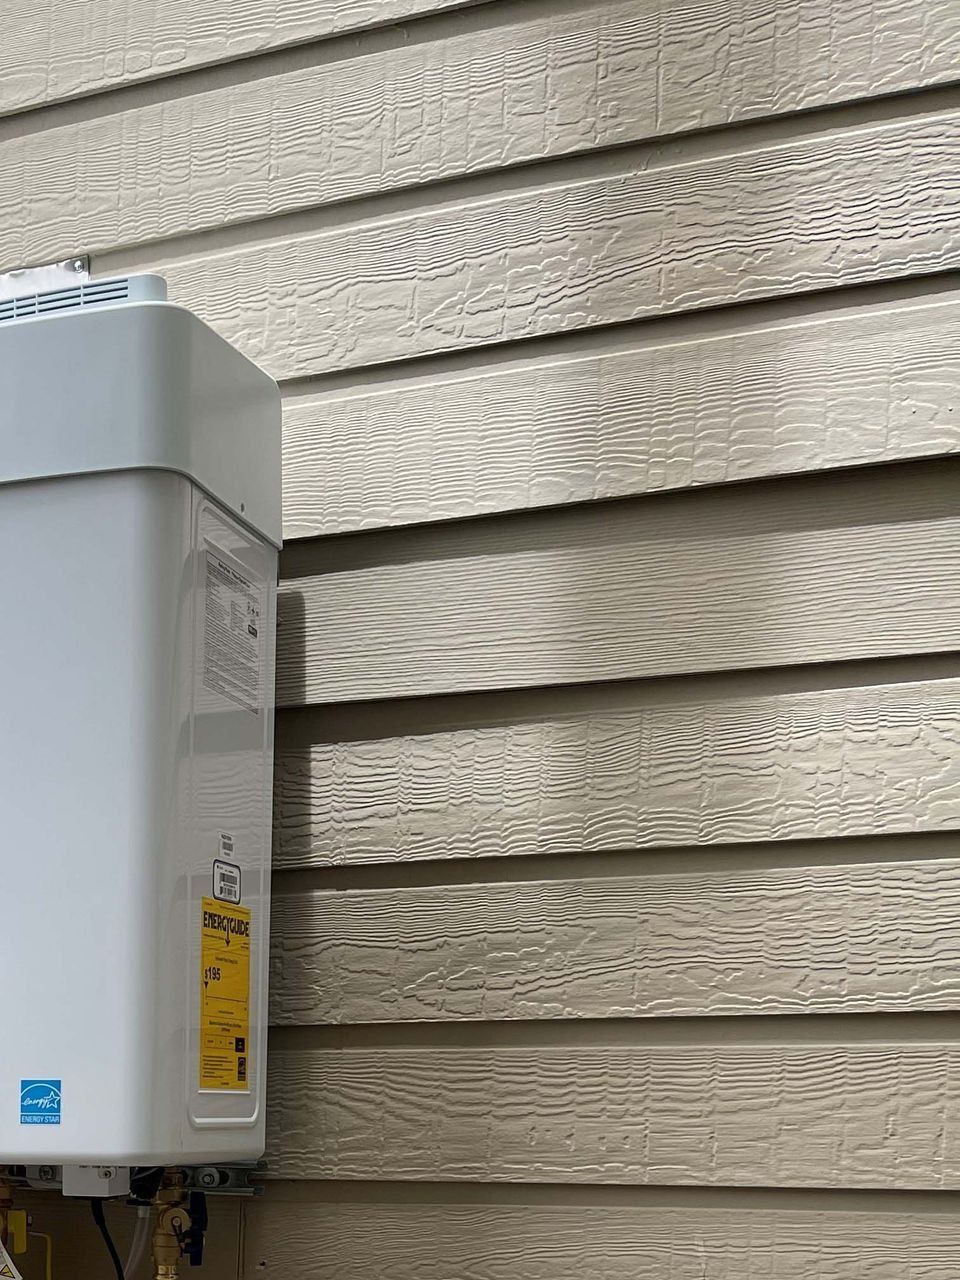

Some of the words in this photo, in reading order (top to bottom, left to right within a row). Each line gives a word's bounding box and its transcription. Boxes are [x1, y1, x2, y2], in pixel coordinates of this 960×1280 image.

[204, 966, 221, 981] $195
[21, 1115, 44, 1123] ENERGY
[44, 1115, 60, 1123] STAR
